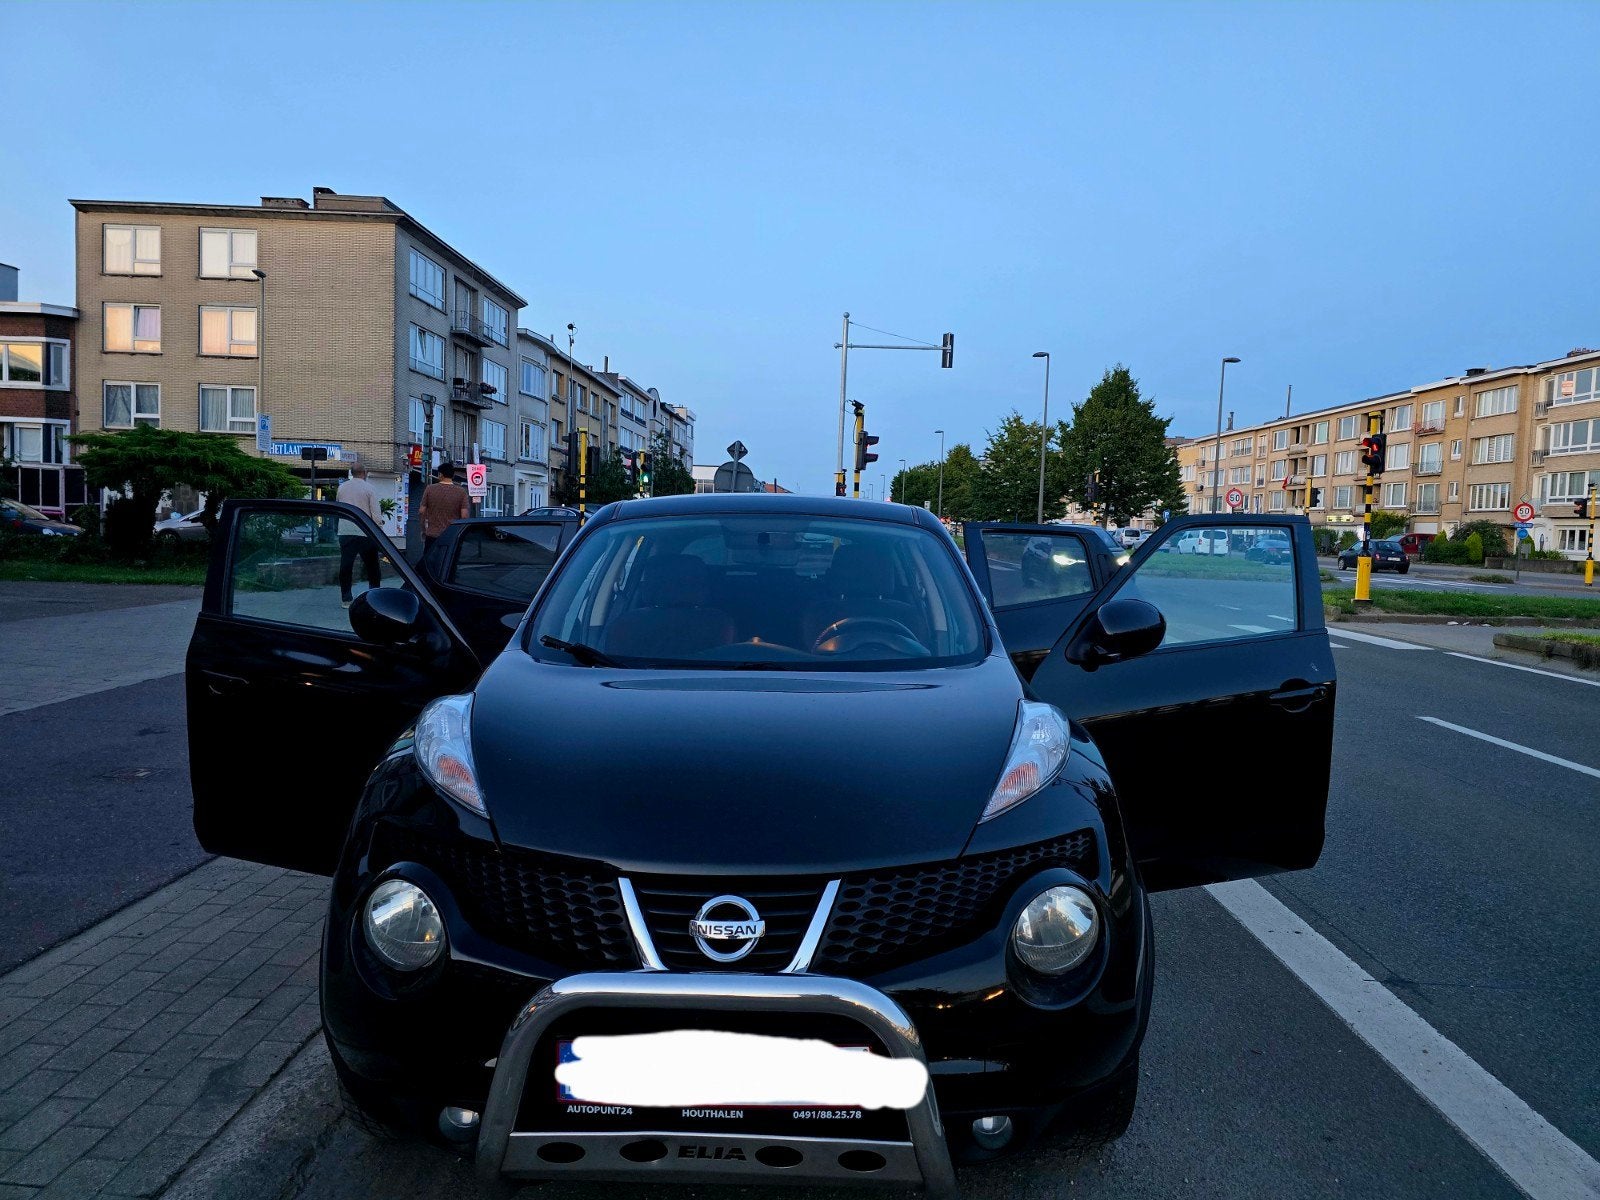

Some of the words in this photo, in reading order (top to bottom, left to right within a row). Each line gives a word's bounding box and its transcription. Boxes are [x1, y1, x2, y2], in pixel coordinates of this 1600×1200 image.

[269, 442, 284, 455] HET
[284, 443, 313, 456] LAAT
[1229, 494, 1241, 502] 50
[1519, 507, 1531, 515] 50
[696, 924, 757, 936] NISSAN
[566, 1104, 633, 1116] AUTOPUNT24
[681, 1108, 744, 1119] HOUTHALEN
[792, 1109, 863, 1120] 0491/88.25.78
[677, 1145, 748, 1161] ELIA
